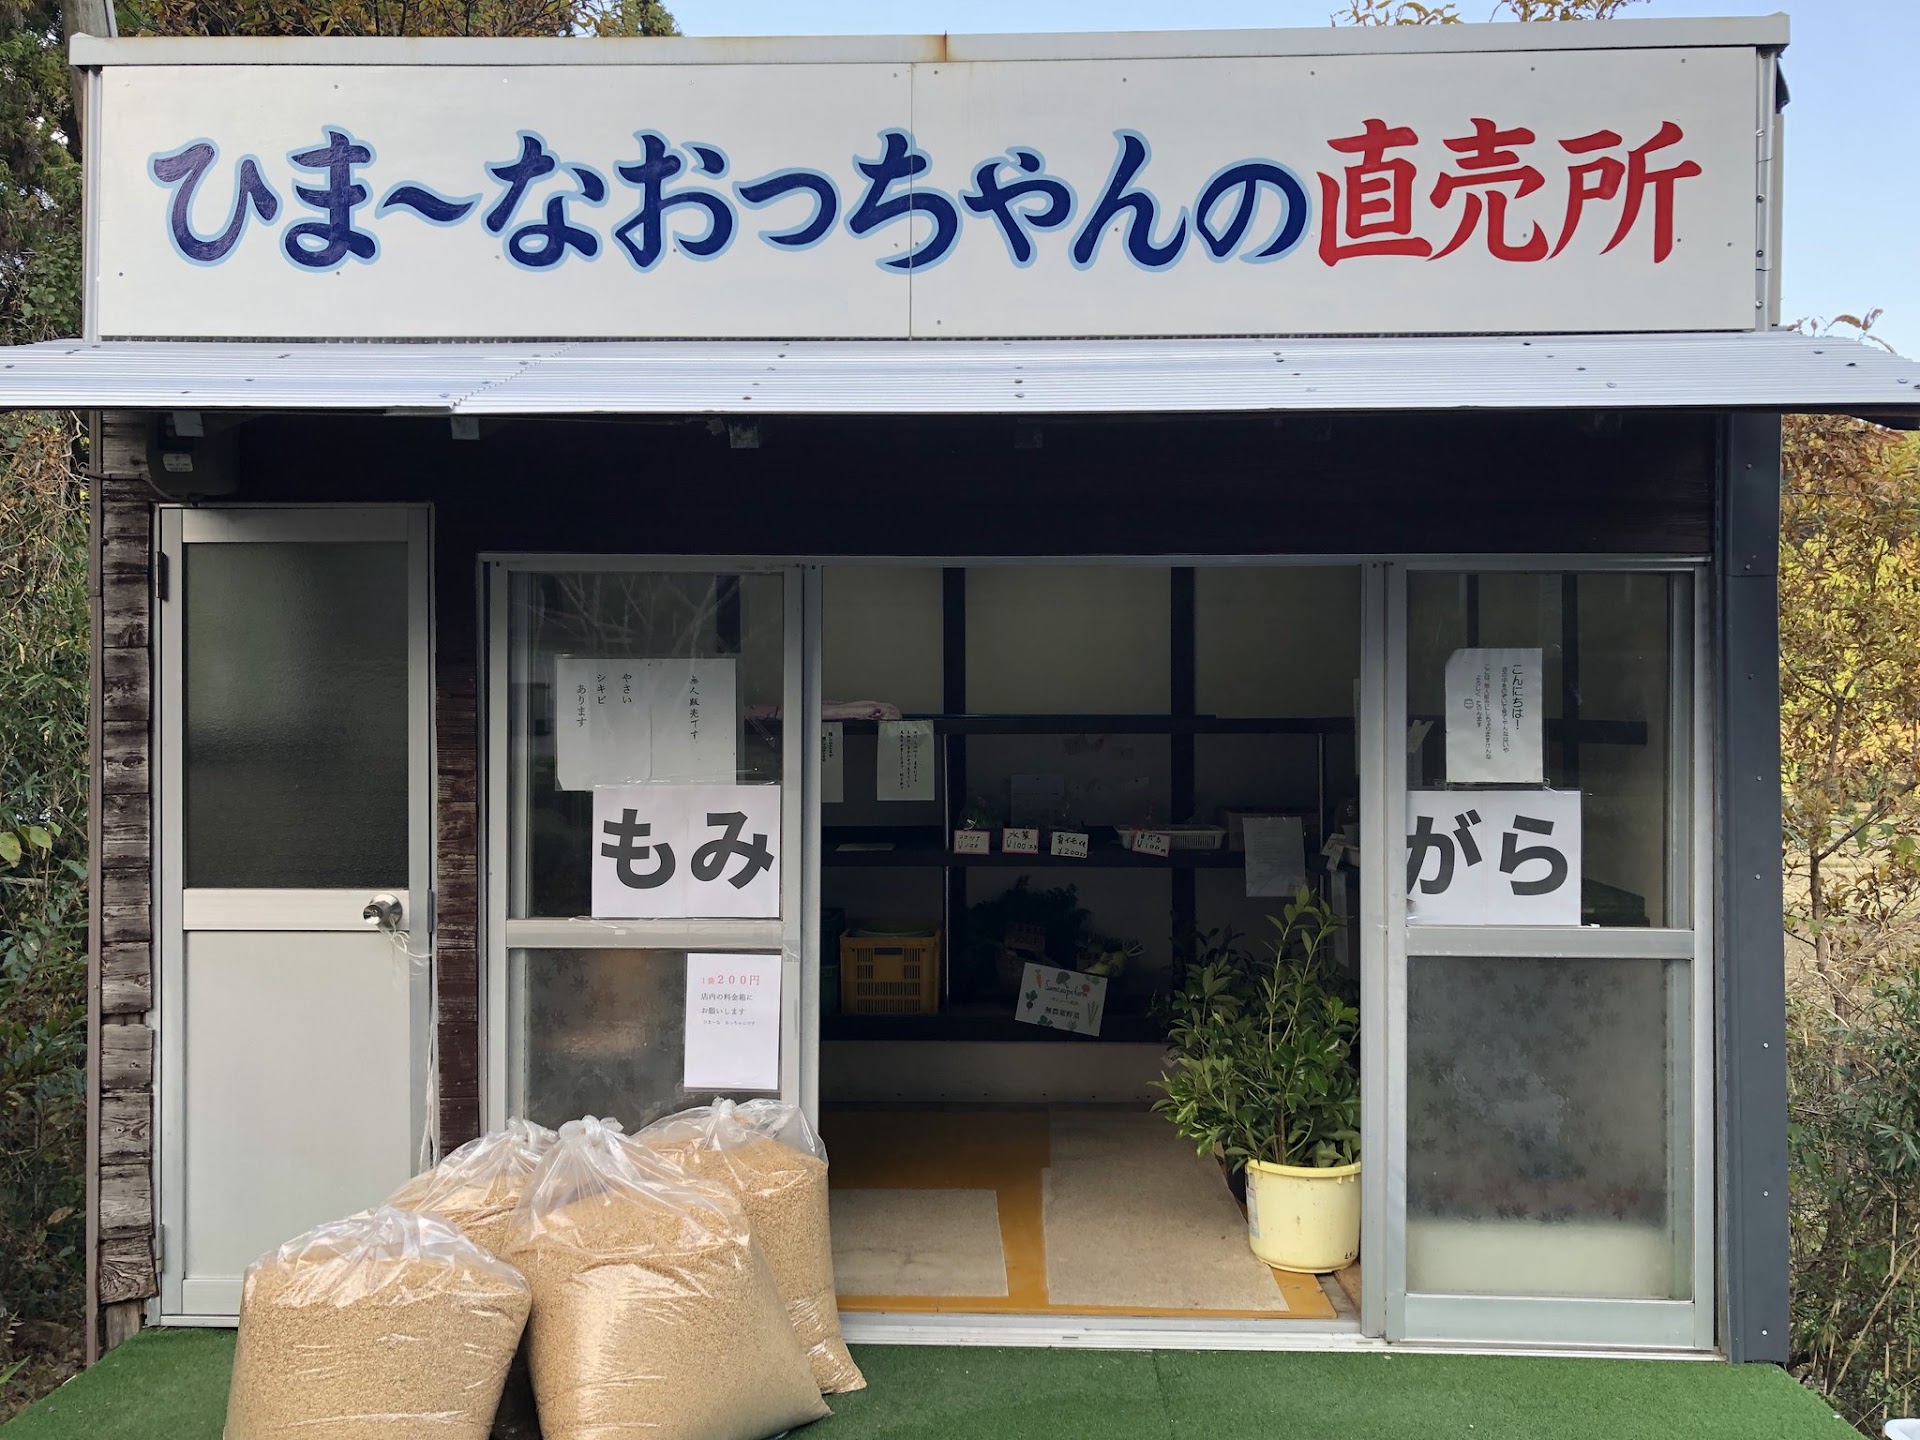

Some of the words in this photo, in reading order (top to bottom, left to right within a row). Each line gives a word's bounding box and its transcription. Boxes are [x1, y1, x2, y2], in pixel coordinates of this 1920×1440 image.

[597, 674, 606, 704] シキビ
[621, 673, 632, 704] やさい
[577, 684, 587, 727] あります
[601, 808, 774, 889] もみ
[1407, 809, 1568, 895] がら
[701, 992, 753, 1001] 店内の料金箱に
[701, 1007, 745, 1015] お願いします
